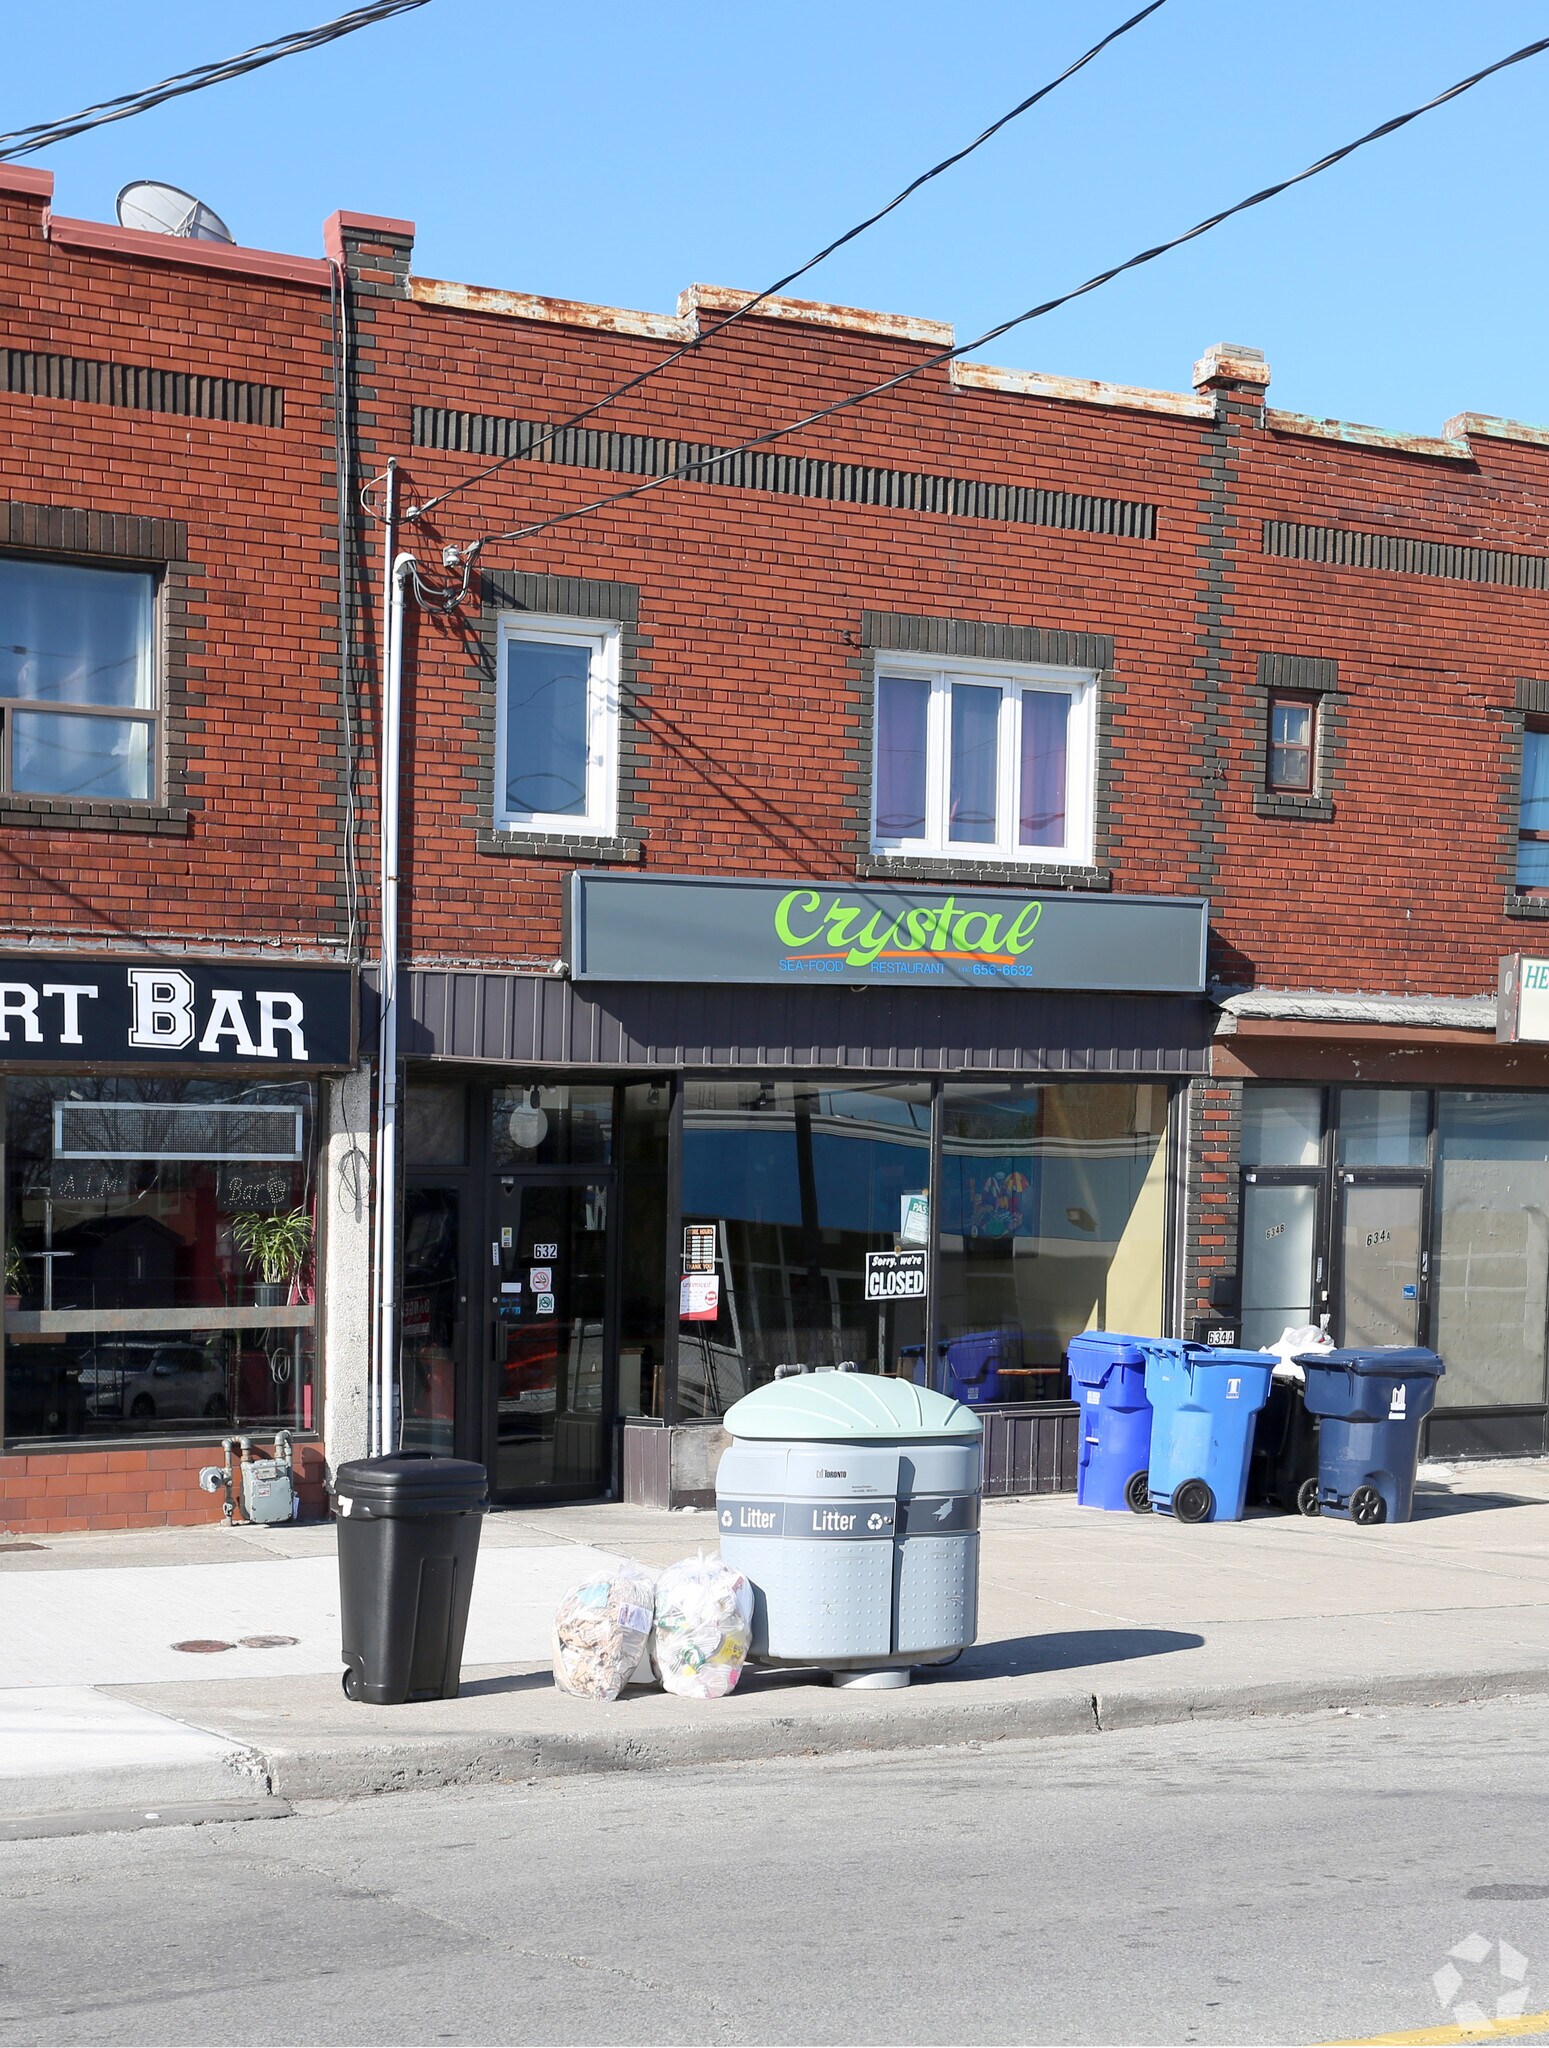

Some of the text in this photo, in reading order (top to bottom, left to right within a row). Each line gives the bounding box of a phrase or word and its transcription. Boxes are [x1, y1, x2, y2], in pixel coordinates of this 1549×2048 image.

[774, 889, 1043, 967] Crystal
[779, 959, 844, 972] SEA-FOOD
[870, 961, 946, 975] RESTAURANT
[972, 963, 1033, 977] 656-6632
[0, 982, 98, 1045] RT
[228, 1177, 266, 1202] Bar
[912, 1202, 929, 1215] PAS
[1366, 1229, 1391, 1247] 634A
[535, 1245, 557, 1258] 632
[872, 1255, 922, 1268] Sorry, we're
[869, 1271, 923, 1295] CLOSED
[1208, 1332, 1233, 1345] 634A
[740, 1507, 776, 1529] Litter
[812, 1509, 856, 1531] Litter
